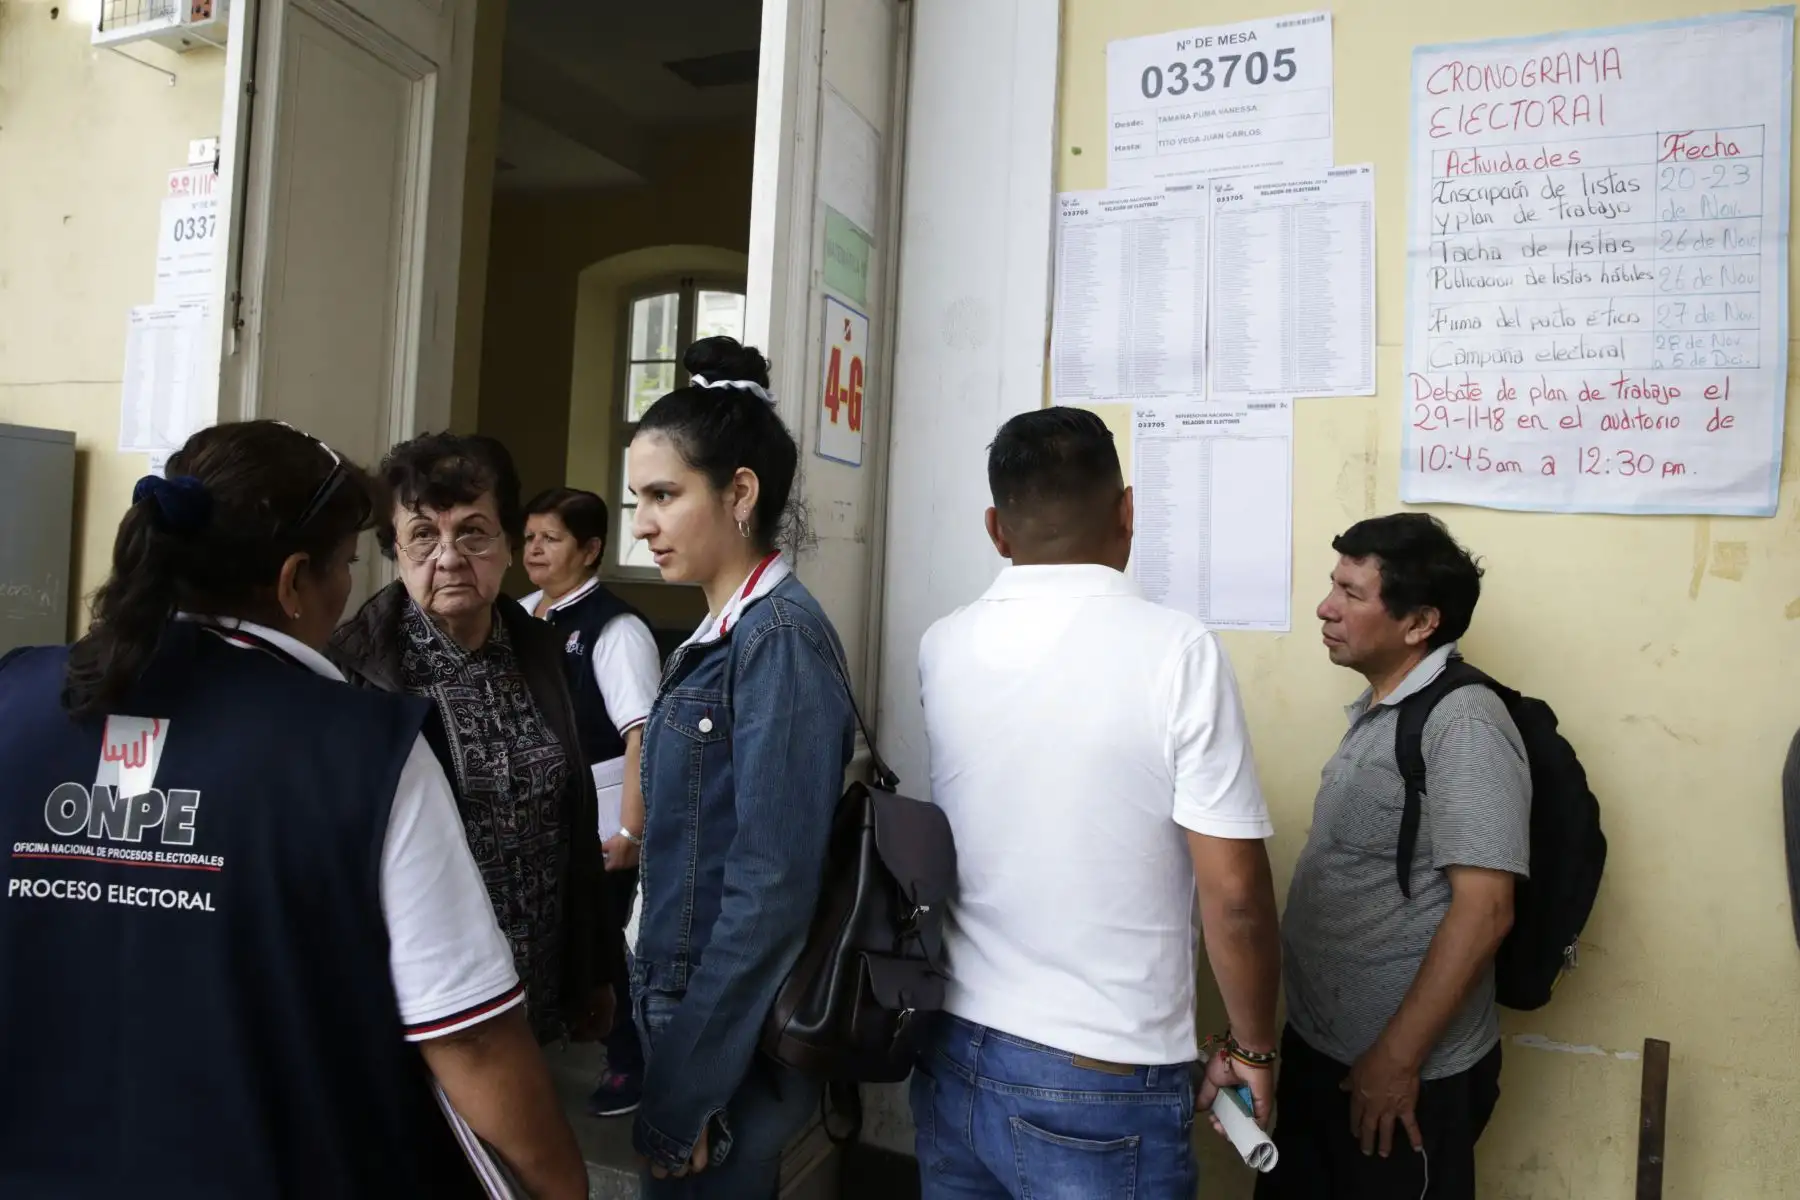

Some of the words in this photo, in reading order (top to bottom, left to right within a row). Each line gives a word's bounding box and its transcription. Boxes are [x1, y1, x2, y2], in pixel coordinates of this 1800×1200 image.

[1195, 36, 1213, 49] DE
[1217, 31, 1257, 46] MESA
[1141, 47, 1297, 99] 033705
[1426, 47, 1622, 95] CRONOGRAMA
[1218, 104, 1257, 115] VANESSA
[1158, 139, 1176, 147] TITO
[1178, 136, 1201, 145] VEGA
[1202, 133, 1224, 142] JUAN
[1226, 128, 1261, 139] CARLOS
[1658, 130, 1740, 162] Fecha
[1446, 147, 1581, 178] Actividades
[1541, 174, 1566, 198] de
[1582, 167, 1641, 196] listas
[1216, 194, 1244, 203] 033705
[1662, 197, 1686, 221] de
[1513, 203, 1541, 224] de
[1522, 233, 1548, 257] de
[1567, 227, 1635, 257] listas
[1660, 229, 1688, 253] 26
[1693, 230, 1715, 251] de
[1525, 267, 1546, 286] de
[1552, 262, 1592, 285] listas
[1693, 267, 1714, 289] de
[1496, 303, 1521, 329] del
[1657, 302, 1687, 328] 27
[1695, 303, 1715, 323] de
[1535, 334, 1625, 363] electoral
[1685, 334, 1705, 350] de
[1672, 352, 1684, 368] 5
[1690, 350, 1707, 367] de
[825, 345, 863, 432] 4-G
[1408, 372, 1482, 402] Debate
[1497, 376, 1517, 400] de
[1530, 374, 1568, 406] plan
[1578, 380, 1606, 402] de
[1703, 375, 1729, 401] el
[1517, 413, 1549, 430] en
[1559, 404, 1583, 429] el
[1600, 405, 1680, 431] auditorio
[1706, 407, 1735, 432] de
[1541, 455, 1556, 476] a
[44, 782, 201, 846] ONPE
[13, 842, 50, 853] OFICINA
[51, 843, 95, 857] NACIONAL
[96, 846, 106, 857] DE
[107, 848, 153, 861] PROCESOS
[154, 851, 225, 867] ELECTORALES
[7, 878, 102, 902] PROCESO
[107, 884, 216, 912] ELECTORAL
